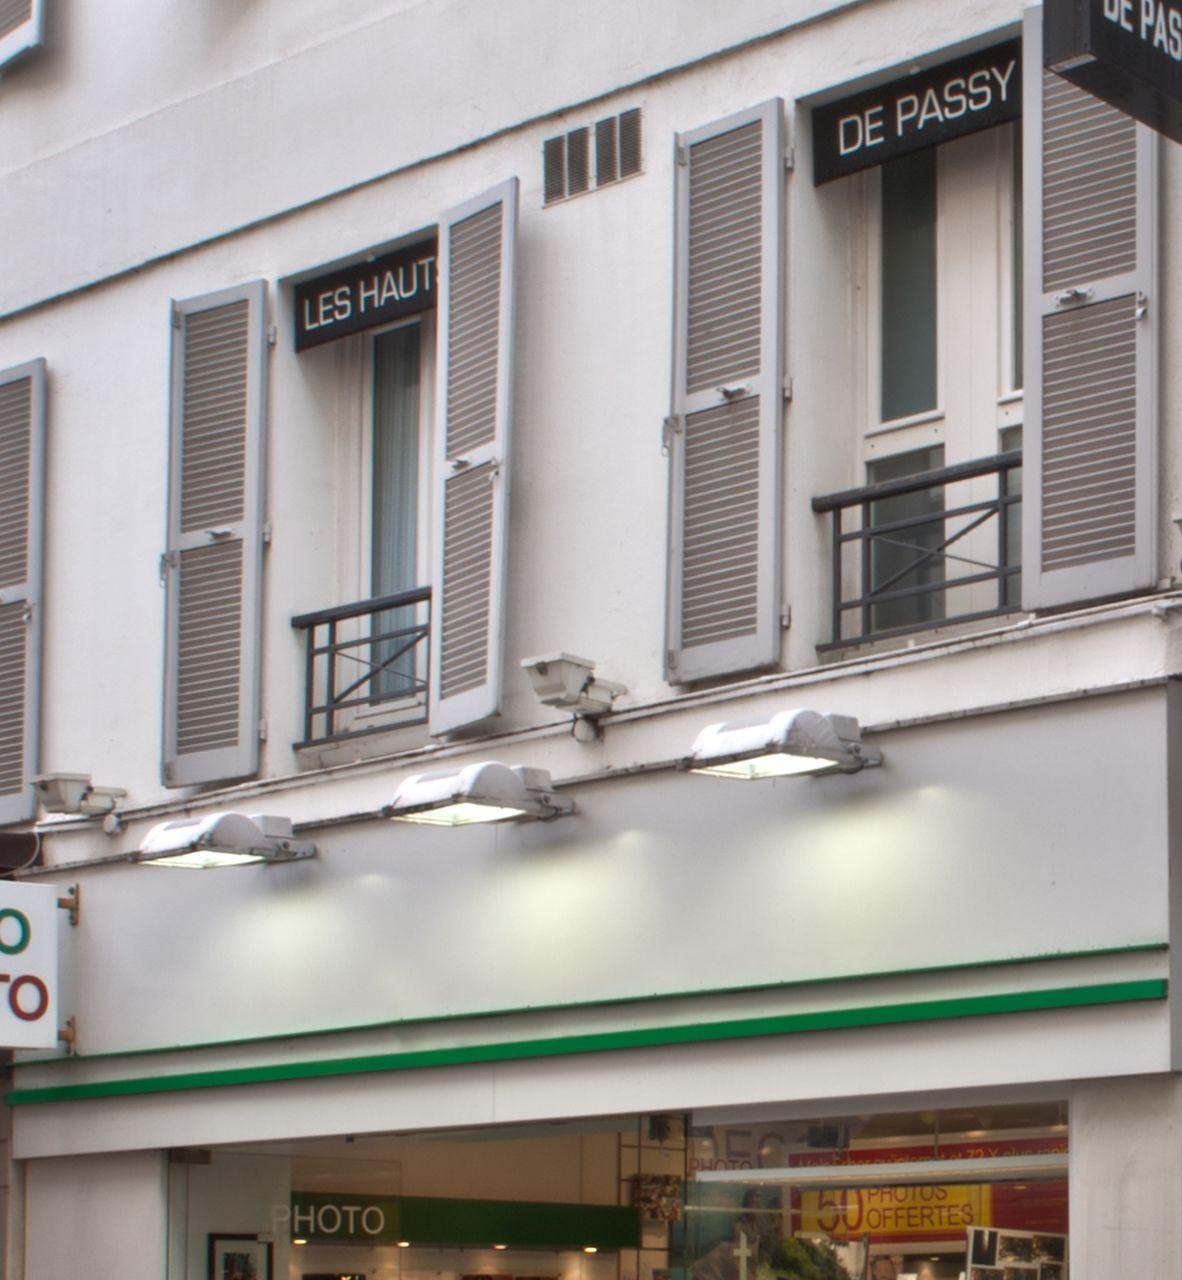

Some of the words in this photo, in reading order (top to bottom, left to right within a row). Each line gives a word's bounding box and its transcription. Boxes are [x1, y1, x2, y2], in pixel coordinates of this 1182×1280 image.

[838, 104, 885, 157] DE
[895, 59, 1017, 137] PASSY
[303, 285, 352, 332] LES
[358, 256, 438, 313] HAUT
[866, 1184, 949, 1205] PHOTOS
[271, 1203, 386, 1235] PHOTO
[866, 1203, 975, 1229] OFFERTES
